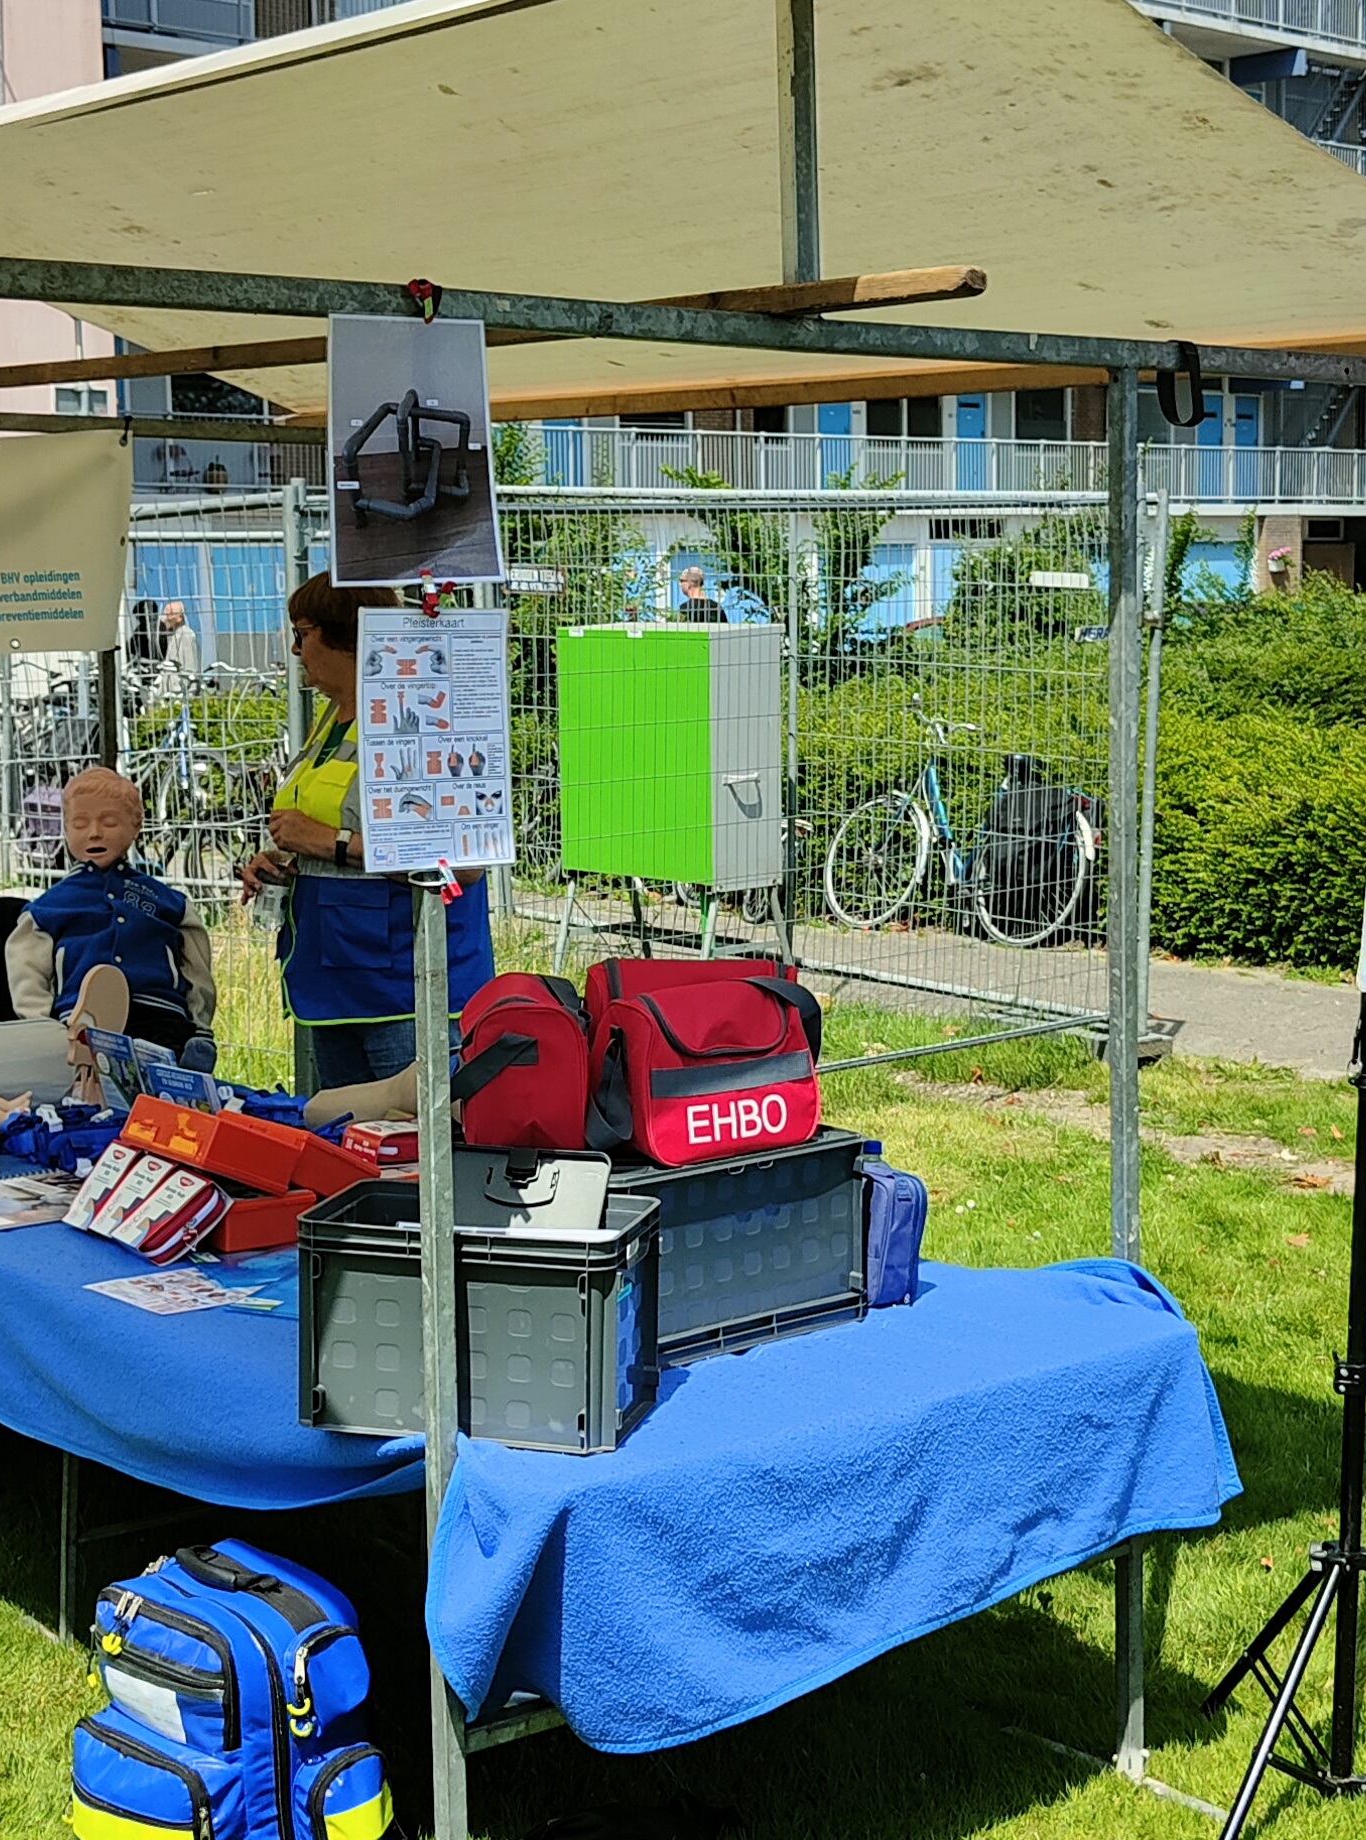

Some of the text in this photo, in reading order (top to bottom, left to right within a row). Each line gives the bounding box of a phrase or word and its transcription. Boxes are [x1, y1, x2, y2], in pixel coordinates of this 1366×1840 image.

[1, 572, 21, 584] BHV
[23, 570, 81, 586] opleidingen
[403, 617, 465, 629] Pleisterkaart
[371, 635, 386, 643] Over
[1079, 627, 1110, 641] HERA
[380, 681, 396, 690] Over
[368, 786, 383, 794] Over
[452, 782, 465, 790] Over
[686, 1093, 788, 1145] EHBO
